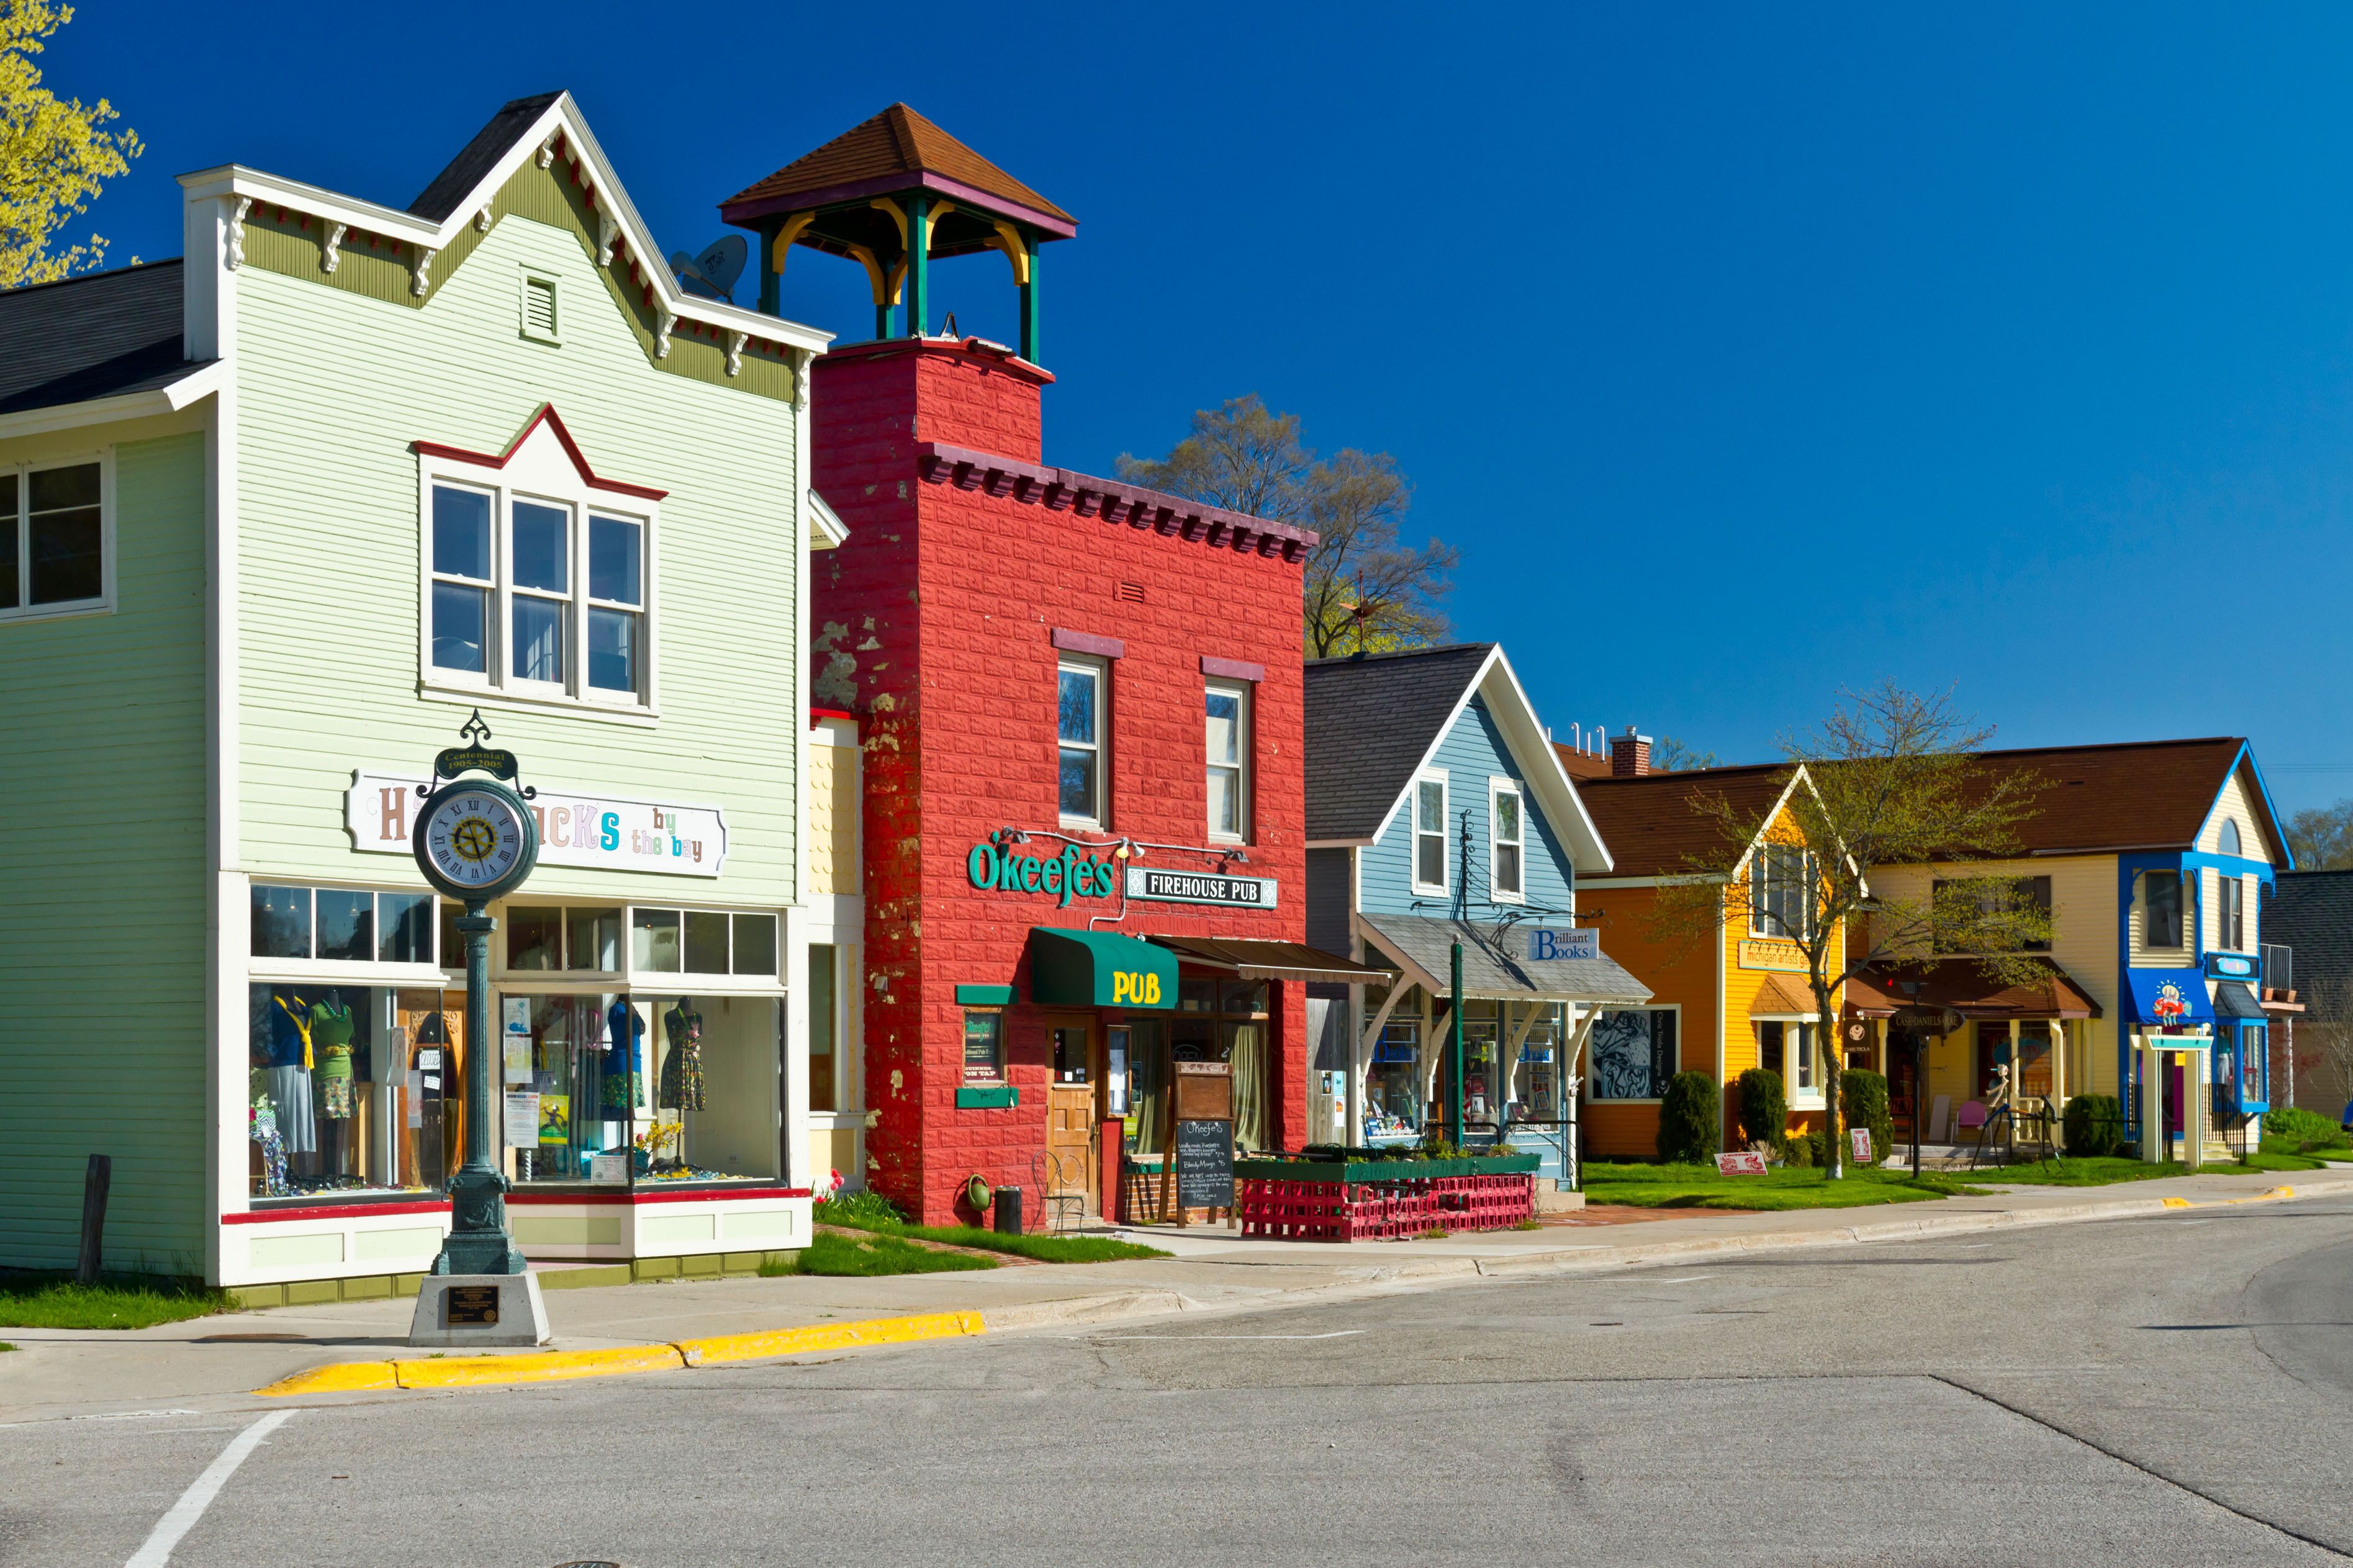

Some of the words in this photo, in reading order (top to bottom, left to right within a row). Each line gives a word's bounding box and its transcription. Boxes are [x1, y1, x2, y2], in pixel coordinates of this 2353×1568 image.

[445, 752, 504, 761] Centennial
[448, 759, 502, 770] 1905-2005
[450, 804, 462, 816] XI
[467, 800, 479, 811] XII
[438, 818, 449, 827] X
[498, 818, 510, 827] II
[653, 807, 676, 835] by
[504, 835, 514, 843] III
[631, 829, 662, 855] the
[671, 835, 702, 863] bay
[437, 849, 451, 865] VIII
[449, 862, 463, 875] VII
[471, 868, 479, 878] VI
[1150, 875, 1226, 898] FIREHOUSE
[1231, 882, 1257, 900] PUB
[1746, 949, 1777, 966] michigan
[1778, 953, 1798, 965] artists
[1113, 971, 1161, 1004] PUB
[1914, 1016, 1941, 1026] DANIELS
[421, 1053, 440, 1066] CLOSED
[1173, 1050, 1203, 1061] OPEN
[1183, 1161, 1199, 1170] Bloody
